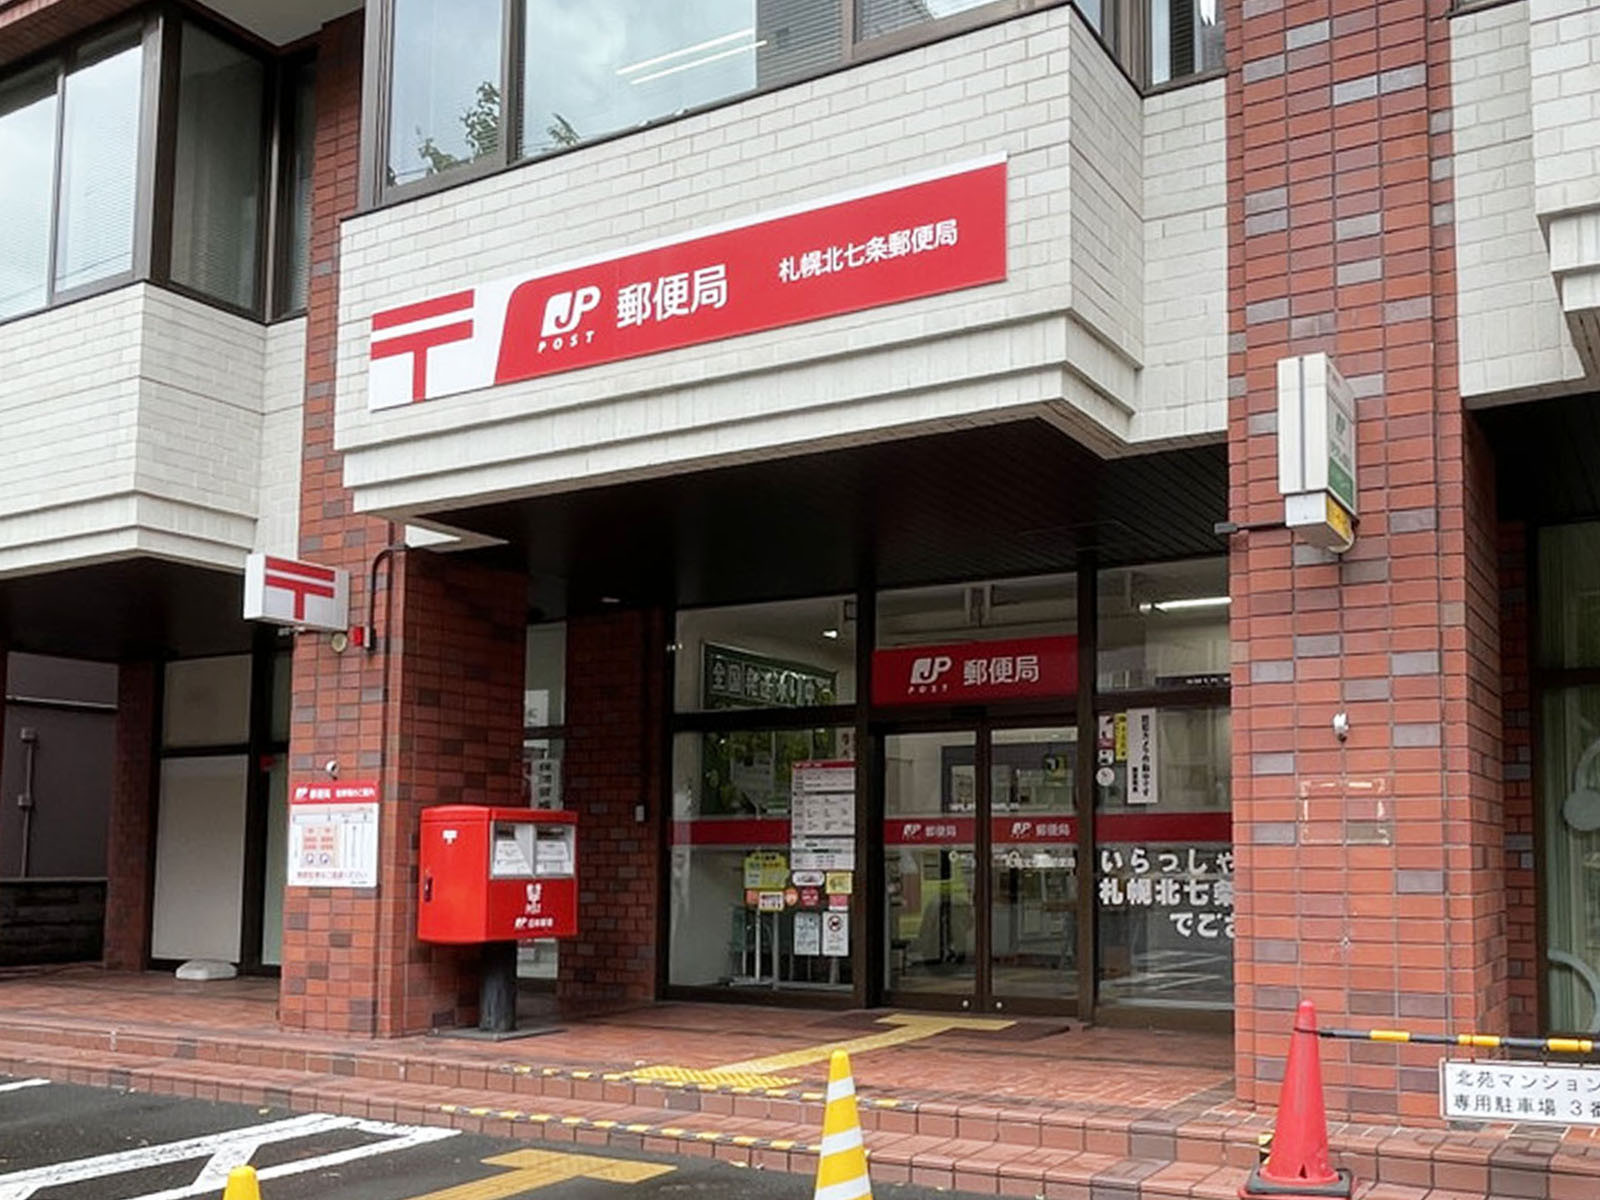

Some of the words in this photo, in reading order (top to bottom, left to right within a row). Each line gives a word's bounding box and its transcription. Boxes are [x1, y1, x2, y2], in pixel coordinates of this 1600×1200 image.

[778, 218, 959, 283] 札幌北七条郵便局
[540, 285, 602, 338] JP
[616, 263, 728, 329] 郵便局
[537, 330, 596, 354] POST
[910, 655, 952, 685] JP
[963, 654, 1041, 686] 郵便局
[1453, 1094, 1556, 1117] 専用駐車場
